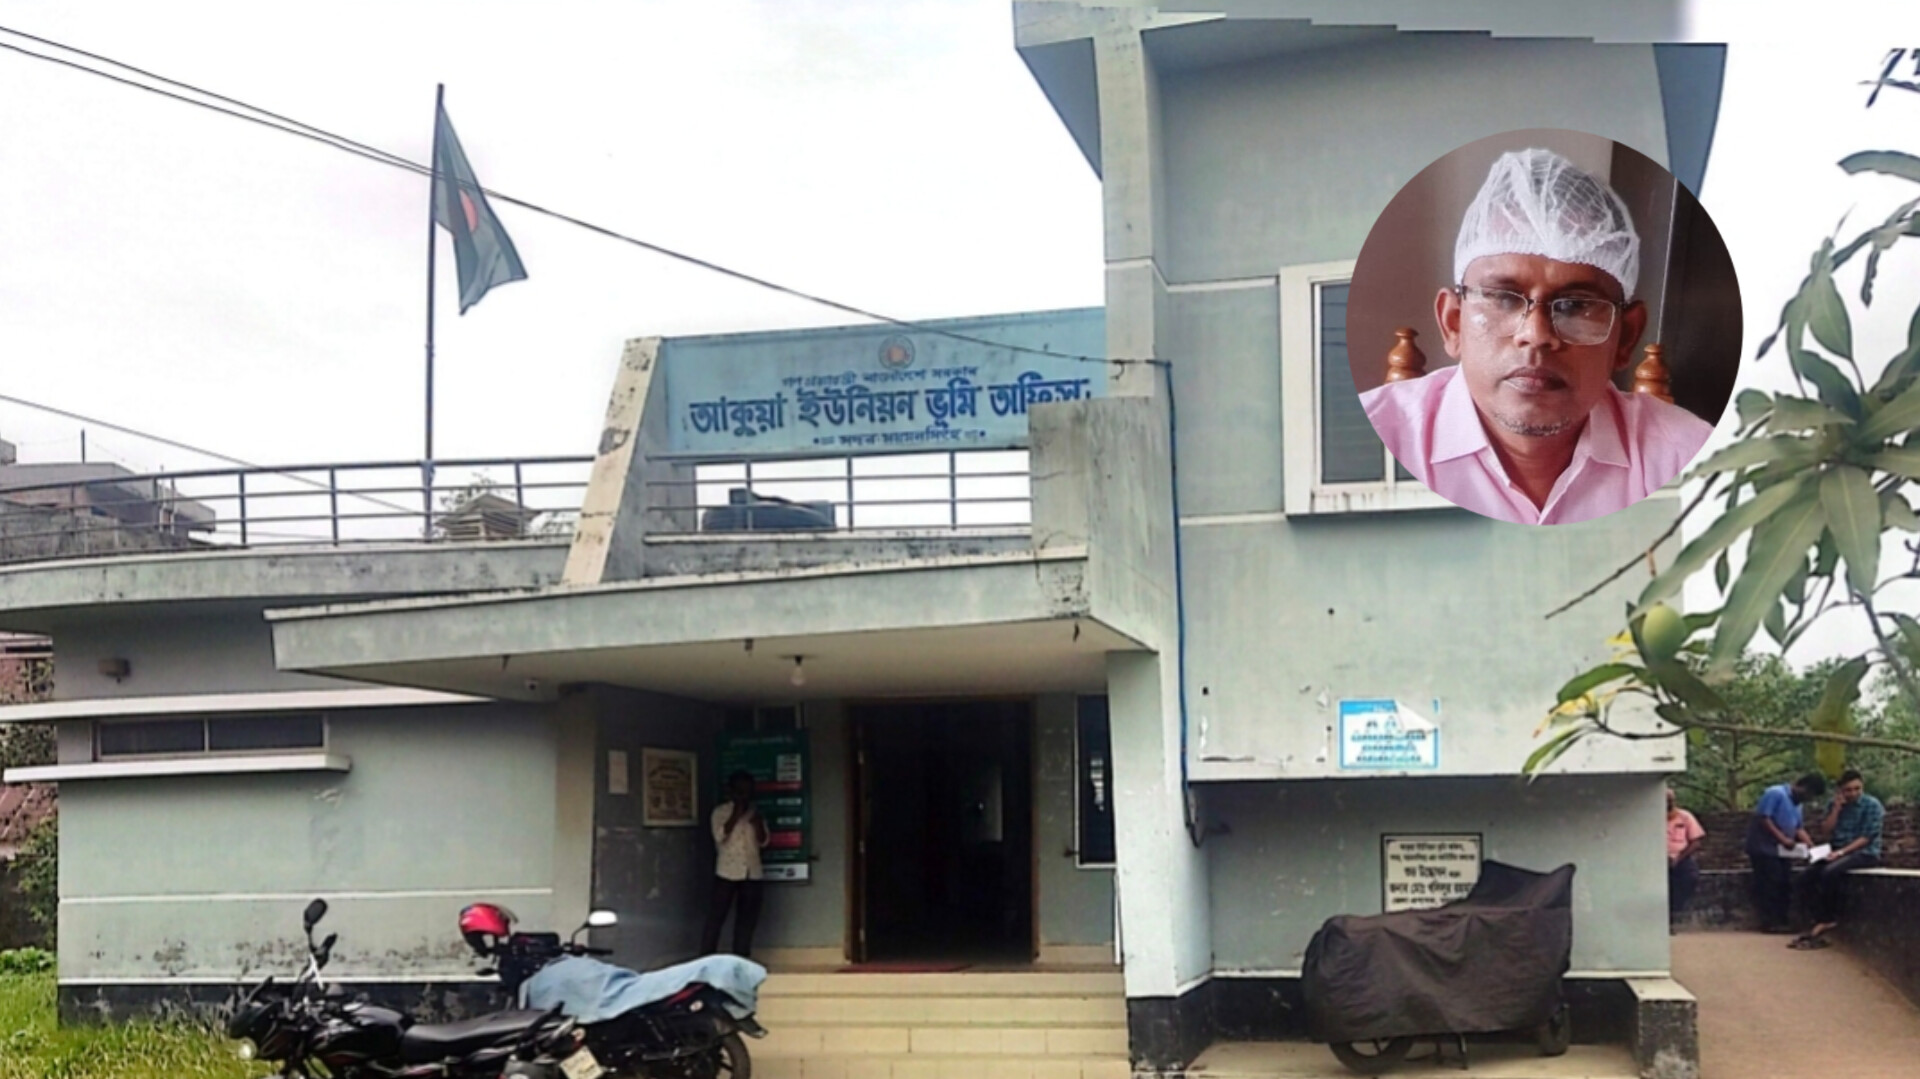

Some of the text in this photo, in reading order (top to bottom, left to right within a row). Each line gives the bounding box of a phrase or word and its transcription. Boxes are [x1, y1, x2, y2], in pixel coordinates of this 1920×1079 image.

[689, 390, 789, 437] আকুয়া
[796, 384, 919, 428] ইউনিয়ন
[924, 376, 983, 430] ভূমি
